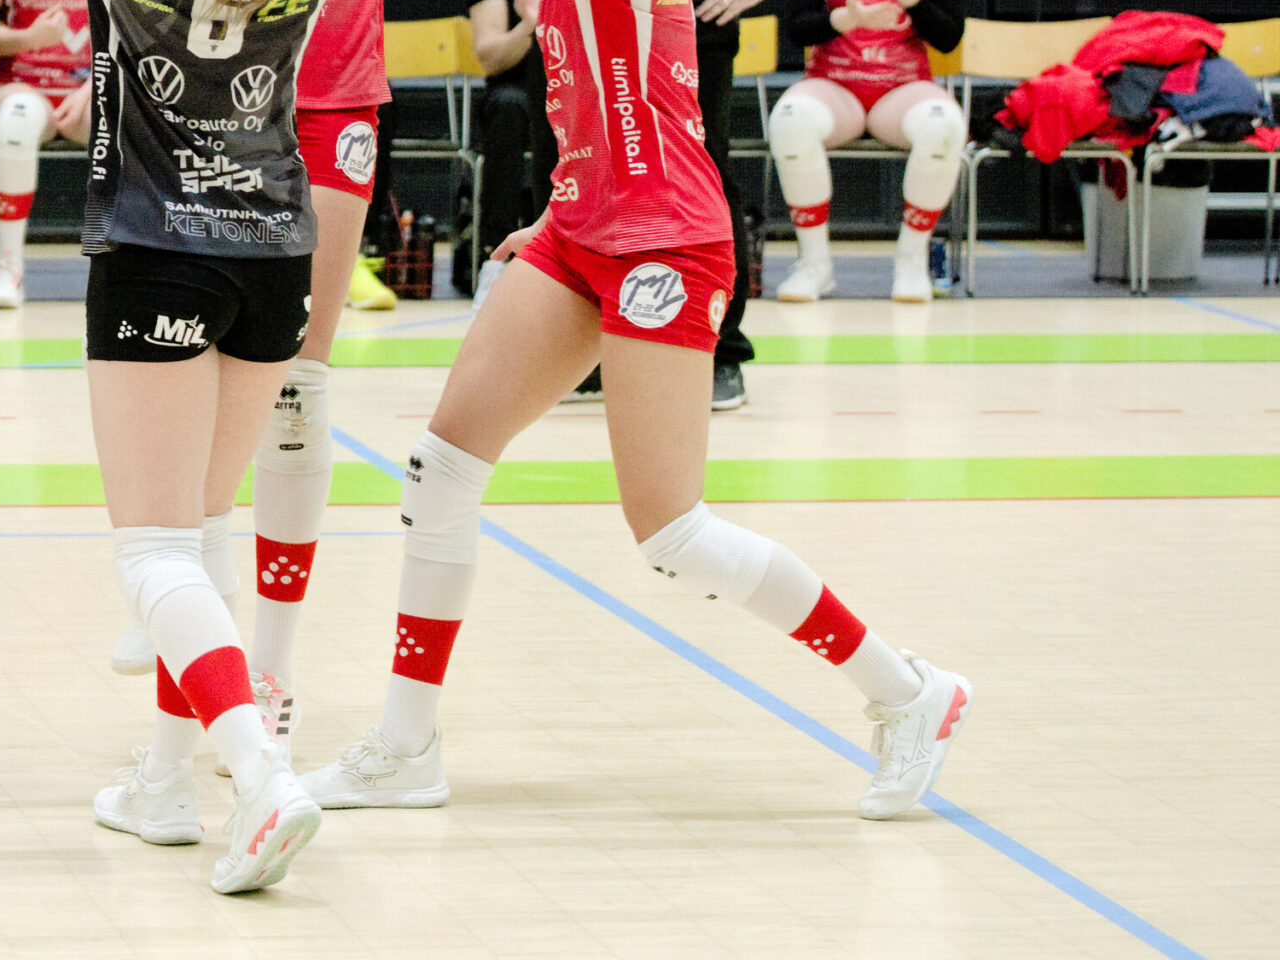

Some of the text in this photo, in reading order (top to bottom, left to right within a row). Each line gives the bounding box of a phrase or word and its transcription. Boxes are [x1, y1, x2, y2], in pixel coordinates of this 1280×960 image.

[243, 114, 267, 133] Oy
[611, 57, 648, 176] tiimipaita.fi
[164, 211, 301, 244] KETONEN
